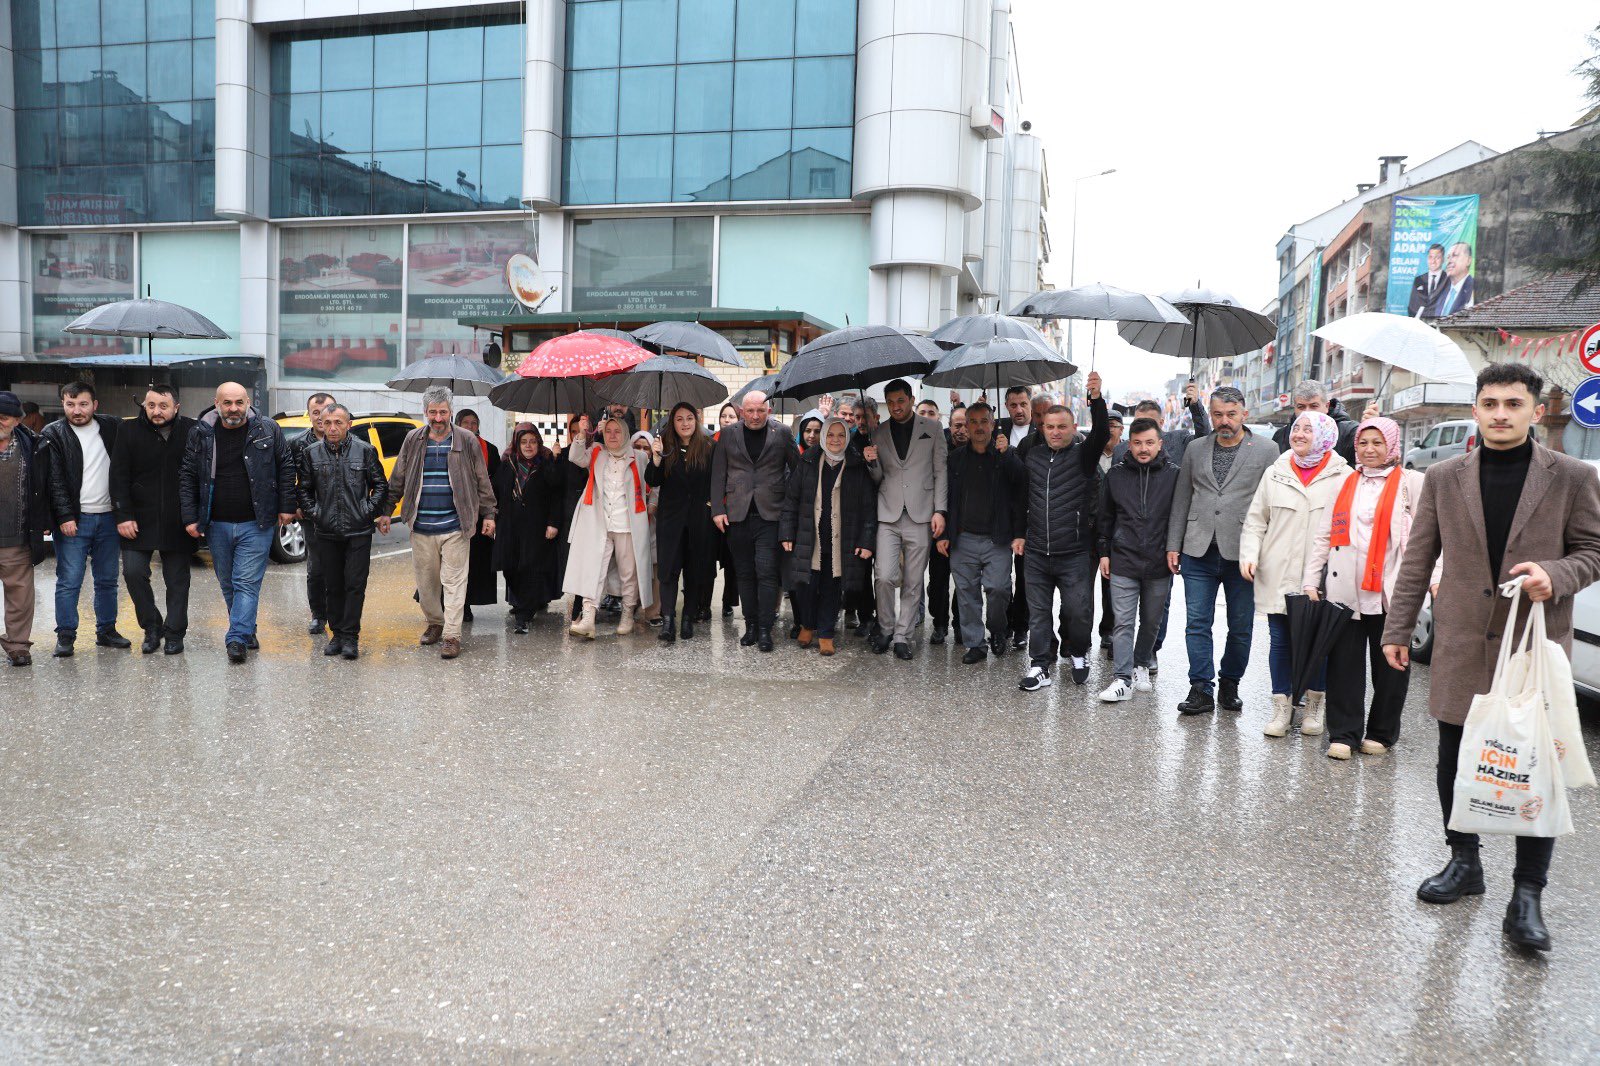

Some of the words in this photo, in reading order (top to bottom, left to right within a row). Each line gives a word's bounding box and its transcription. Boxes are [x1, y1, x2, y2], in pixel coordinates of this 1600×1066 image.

[1394, 230, 1432, 242] DOĞRU
[1394, 243, 1426, 253] ADAM
[1478, 764, 1530, 783] HAZIRIZ
